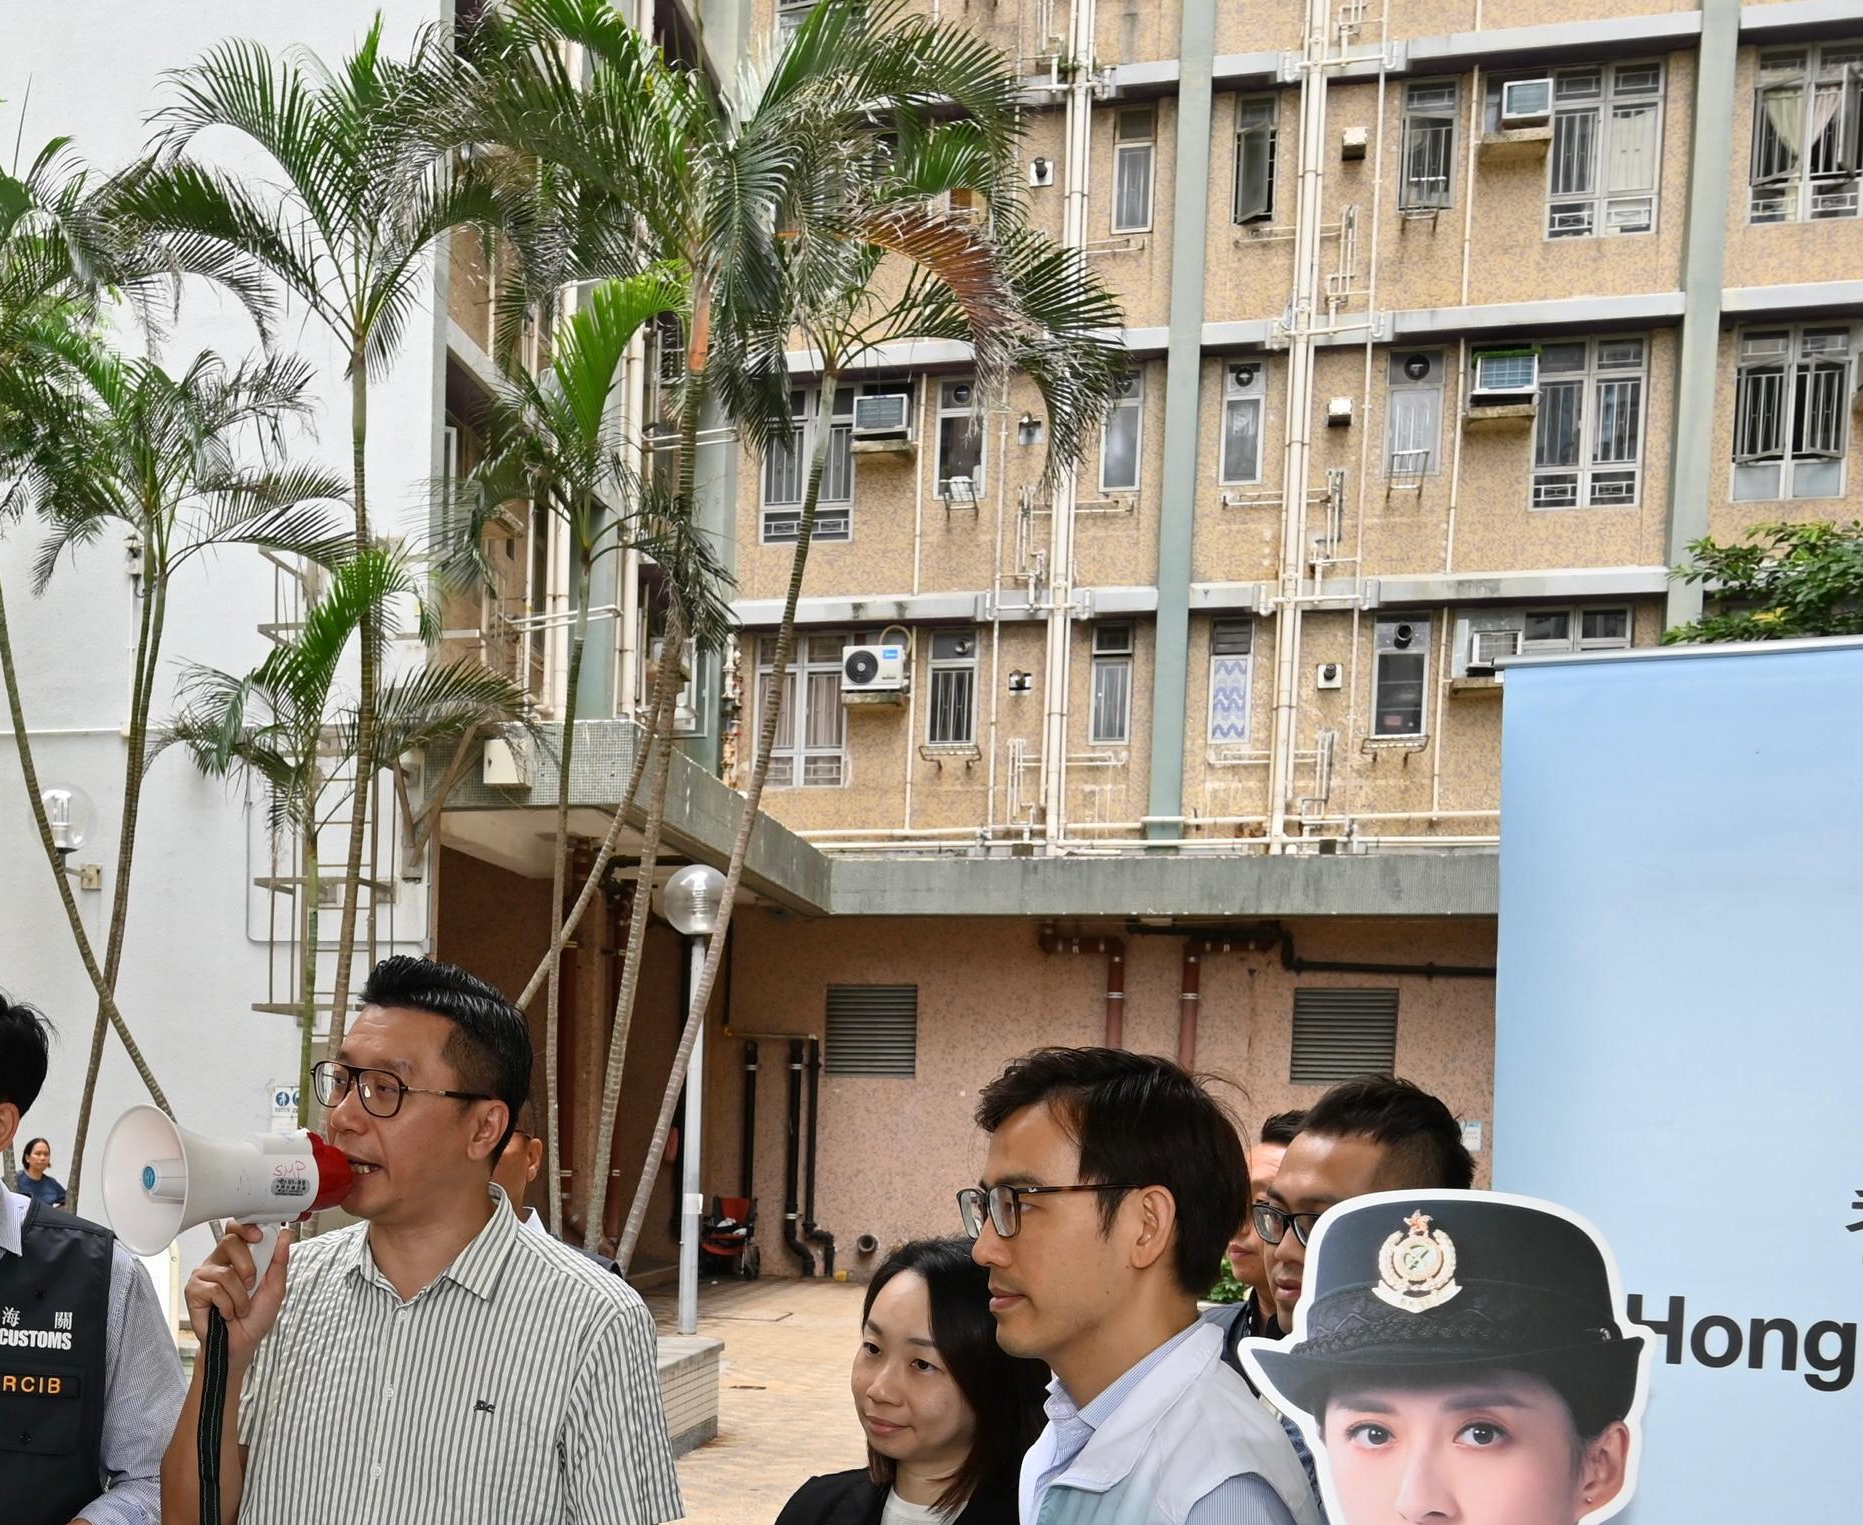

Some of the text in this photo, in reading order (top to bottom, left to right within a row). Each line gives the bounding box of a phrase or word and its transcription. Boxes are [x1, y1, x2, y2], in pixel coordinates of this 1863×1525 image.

[274, 1160, 306, 1178] SMP
[2, 1305, 73, 1331] 海 關
[1626, 1292, 1859, 1393] Hong
[3, 1375, 63, 1394] RCIB
